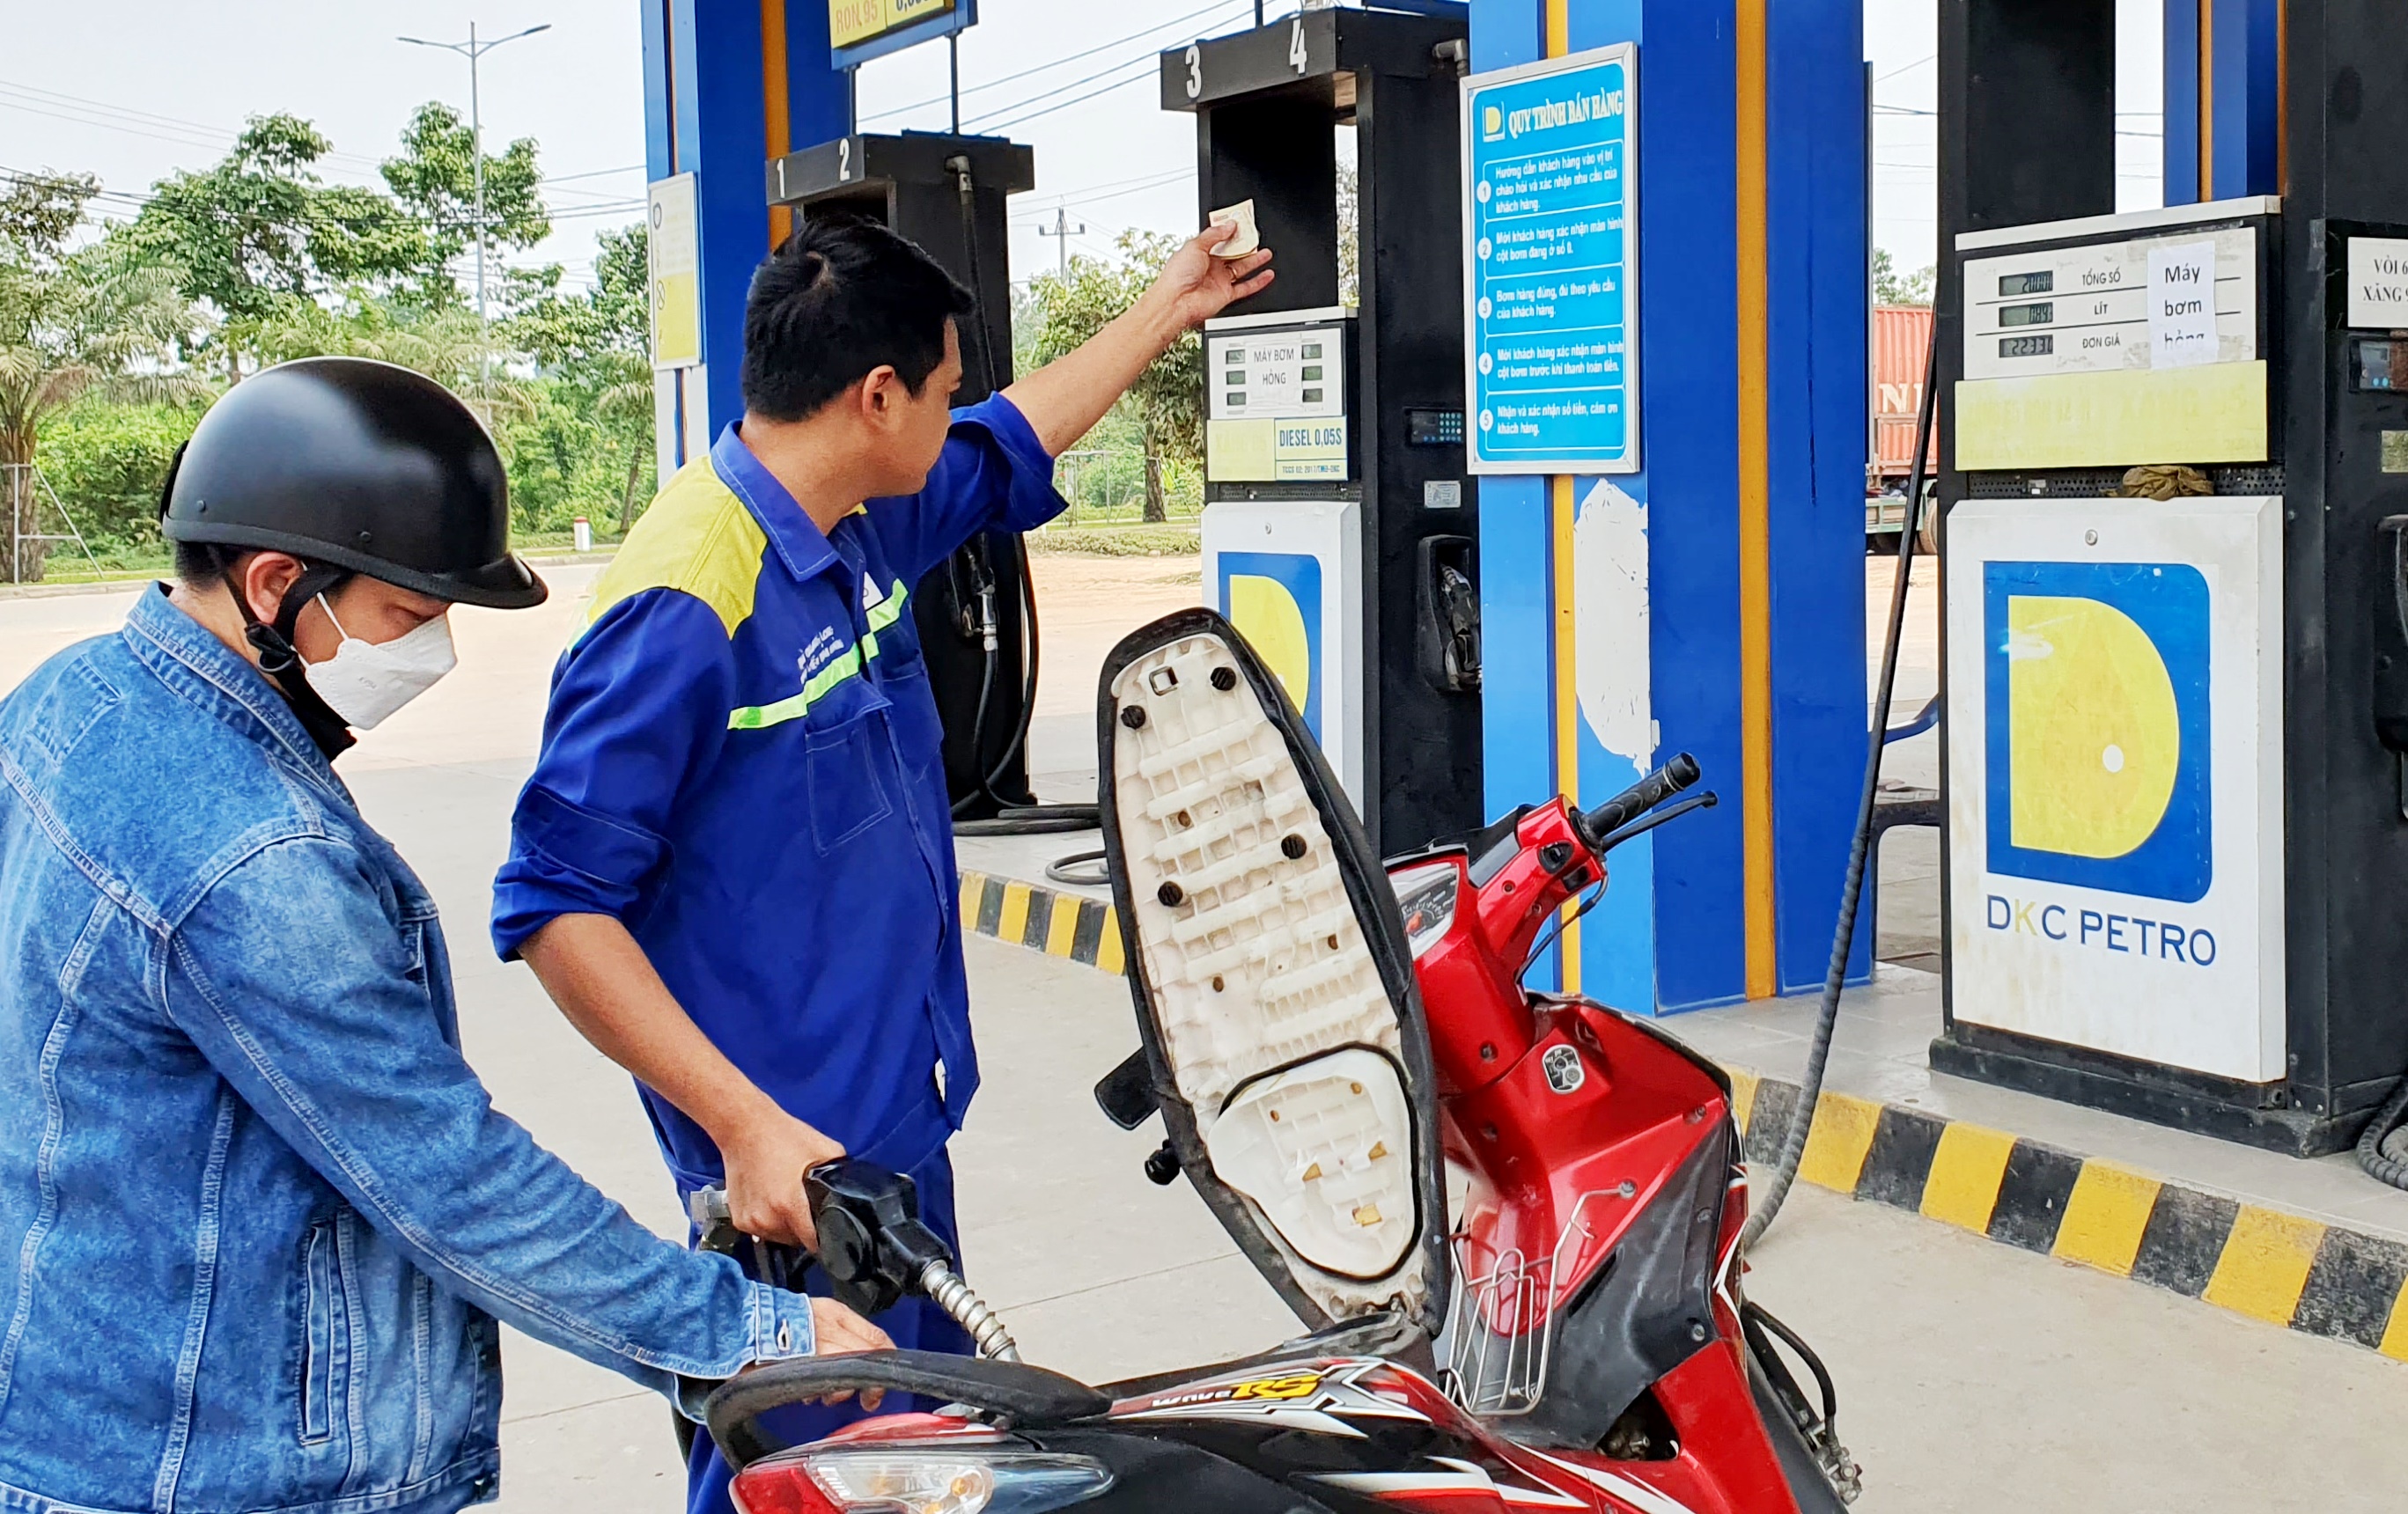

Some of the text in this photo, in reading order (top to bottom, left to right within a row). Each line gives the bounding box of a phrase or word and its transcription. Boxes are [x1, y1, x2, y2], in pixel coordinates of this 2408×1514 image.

[1289, 18, 1307, 74] 4
[1185, 44, 1202, 99] 3
[1508, 87, 1623, 139] QUY TRÌNH BÁN HÀNG
[839, 138, 851, 181] 2
[1538, 158, 1560, 173] khách
[1562, 154, 1580, 170] hàng
[777, 158, 785, 198] 1
[1529, 179, 1538, 192] và
[1539, 177, 1552, 190] xác
[1554, 174, 1572, 190] nhận
[1496, 200, 1518, 214] khách
[1513, 229, 1535, 243] khách
[1557, 223, 1570, 238] xác
[1571, 221, 1588, 237] nhận
[1482, 244, 1488, 255] 2
[1510, 248, 1528, 261] bơm
[2109, 265, 2121, 283] SỐ
[2165, 262, 2200, 284] Máy
[2374, 254, 2397, 275] VÒI
[1496, 290, 1515, 303] Bơm
[1516, 287, 1535, 302] hàng
[1570, 283, 1587, 296] theo
[2363, 282, 2402, 302] XĂNG
[1483, 302, 1488, 313] 3
[1512, 305, 1535, 318] khách
[2095, 301, 2108, 315] LÍT
[2164, 299, 2201, 317] bơm
[2082, 332, 2120, 349] ĐƠN GIÁ
[1254, 348, 1294, 363] MÁY BƠM
[1513, 346, 1535, 360] khách
[1536, 345, 1556, 361] hàng
[1557, 343, 1570, 357] xác
[1571, 342, 1589, 359] nhận
[1483, 359, 1488, 370] 4
[1511, 365, 1528, 378] bơm
[1551, 362, 1563, 375] khi
[1564, 361, 1585, 374] thanh
[1587, 359, 1602, 373] toán
[1263, 368, 1286, 386] HỎNG
[1497, 404, 1517, 420] Nhận
[1518, 404, 1527, 416] và
[1528, 403, 1541, 416] xác
[1543, 402, 1561, 418] nhận
[1484, 415, 1490, 427] 5
[1497, 422, 1519, 434] khách
[1279, 427, 1342, 448] DIESEL 0,05S
[2007, 594, 2180, 859] D
[1985, 893, 2217, 966] DKC PETRO
[1232, 1373, 1324, 1400] RS
